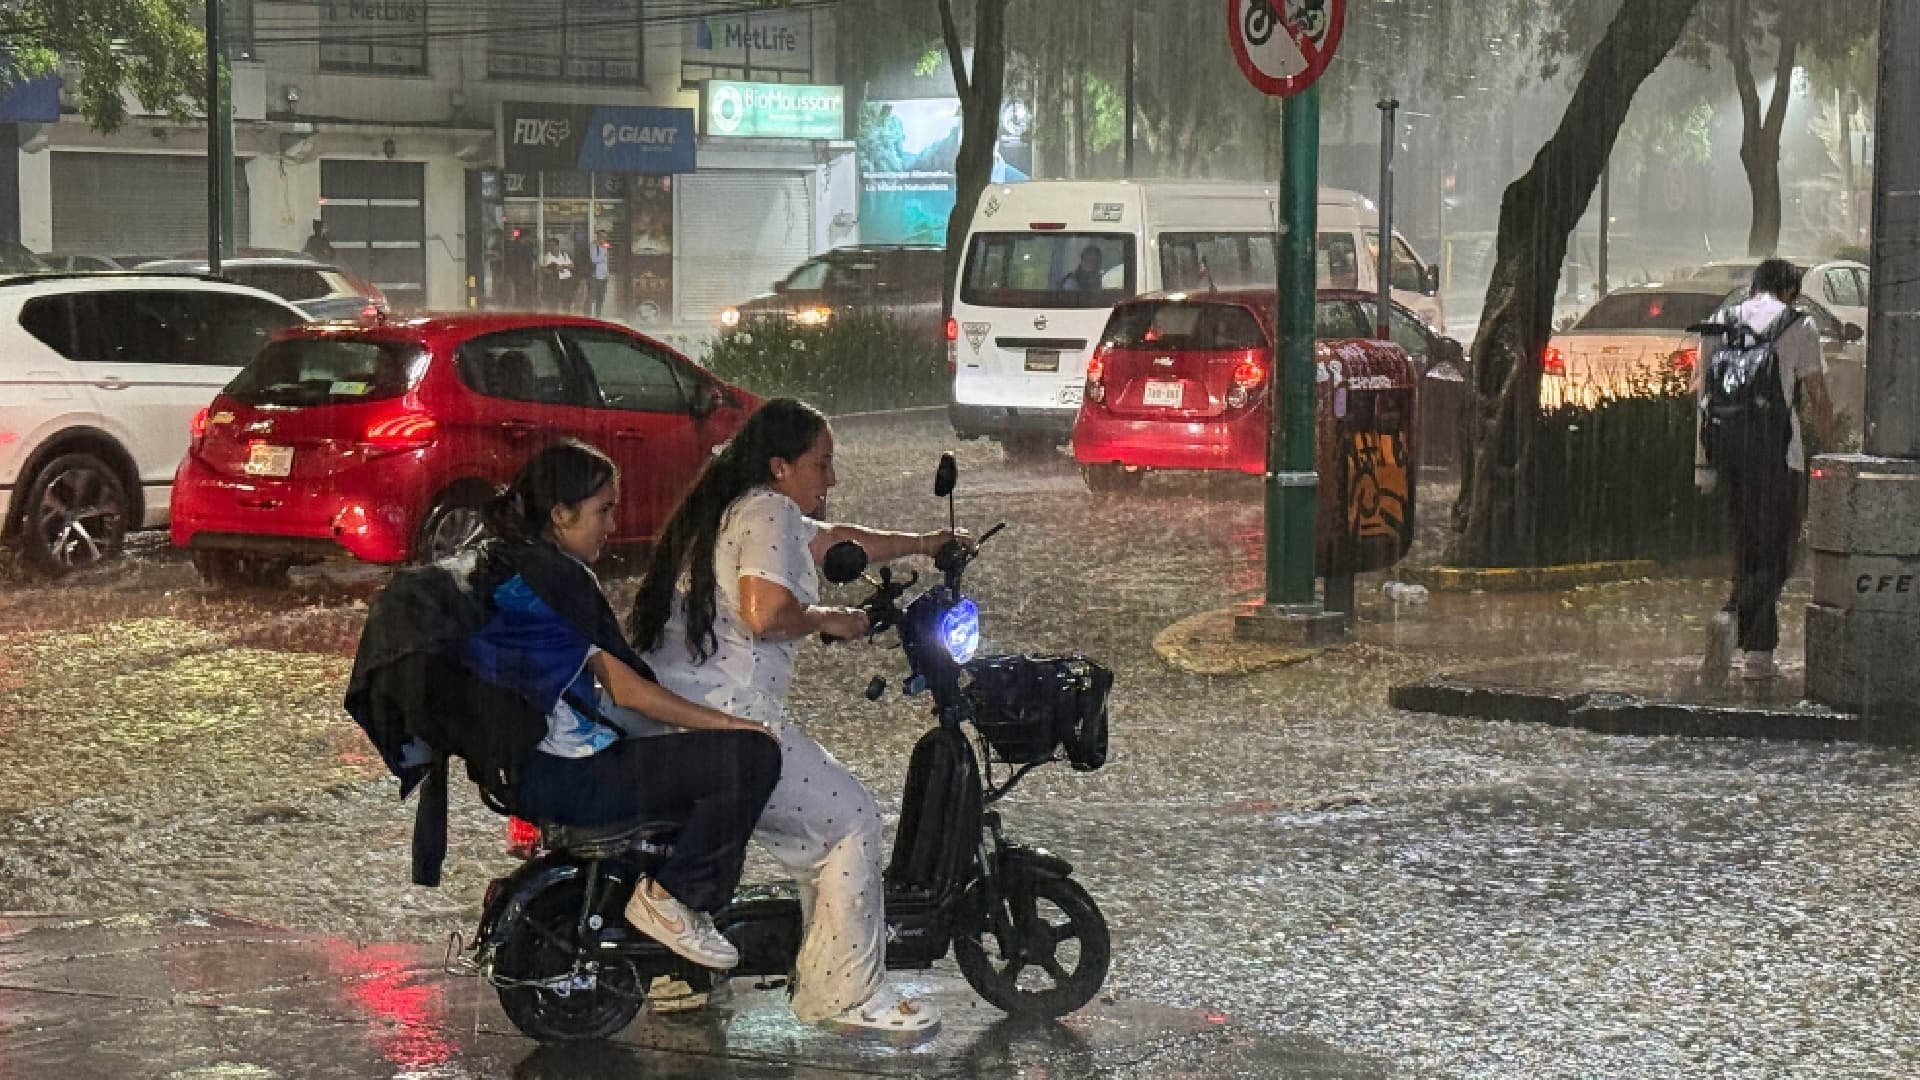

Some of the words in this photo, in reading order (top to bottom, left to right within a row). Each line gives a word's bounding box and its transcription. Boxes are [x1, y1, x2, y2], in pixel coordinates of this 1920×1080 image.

[725, 24, 796, 50] MetLife
[514, 119, 548, 145] FOX
[619, 127, 678, 144] GIANT
[1857, 574, 1913, 593] CFE
